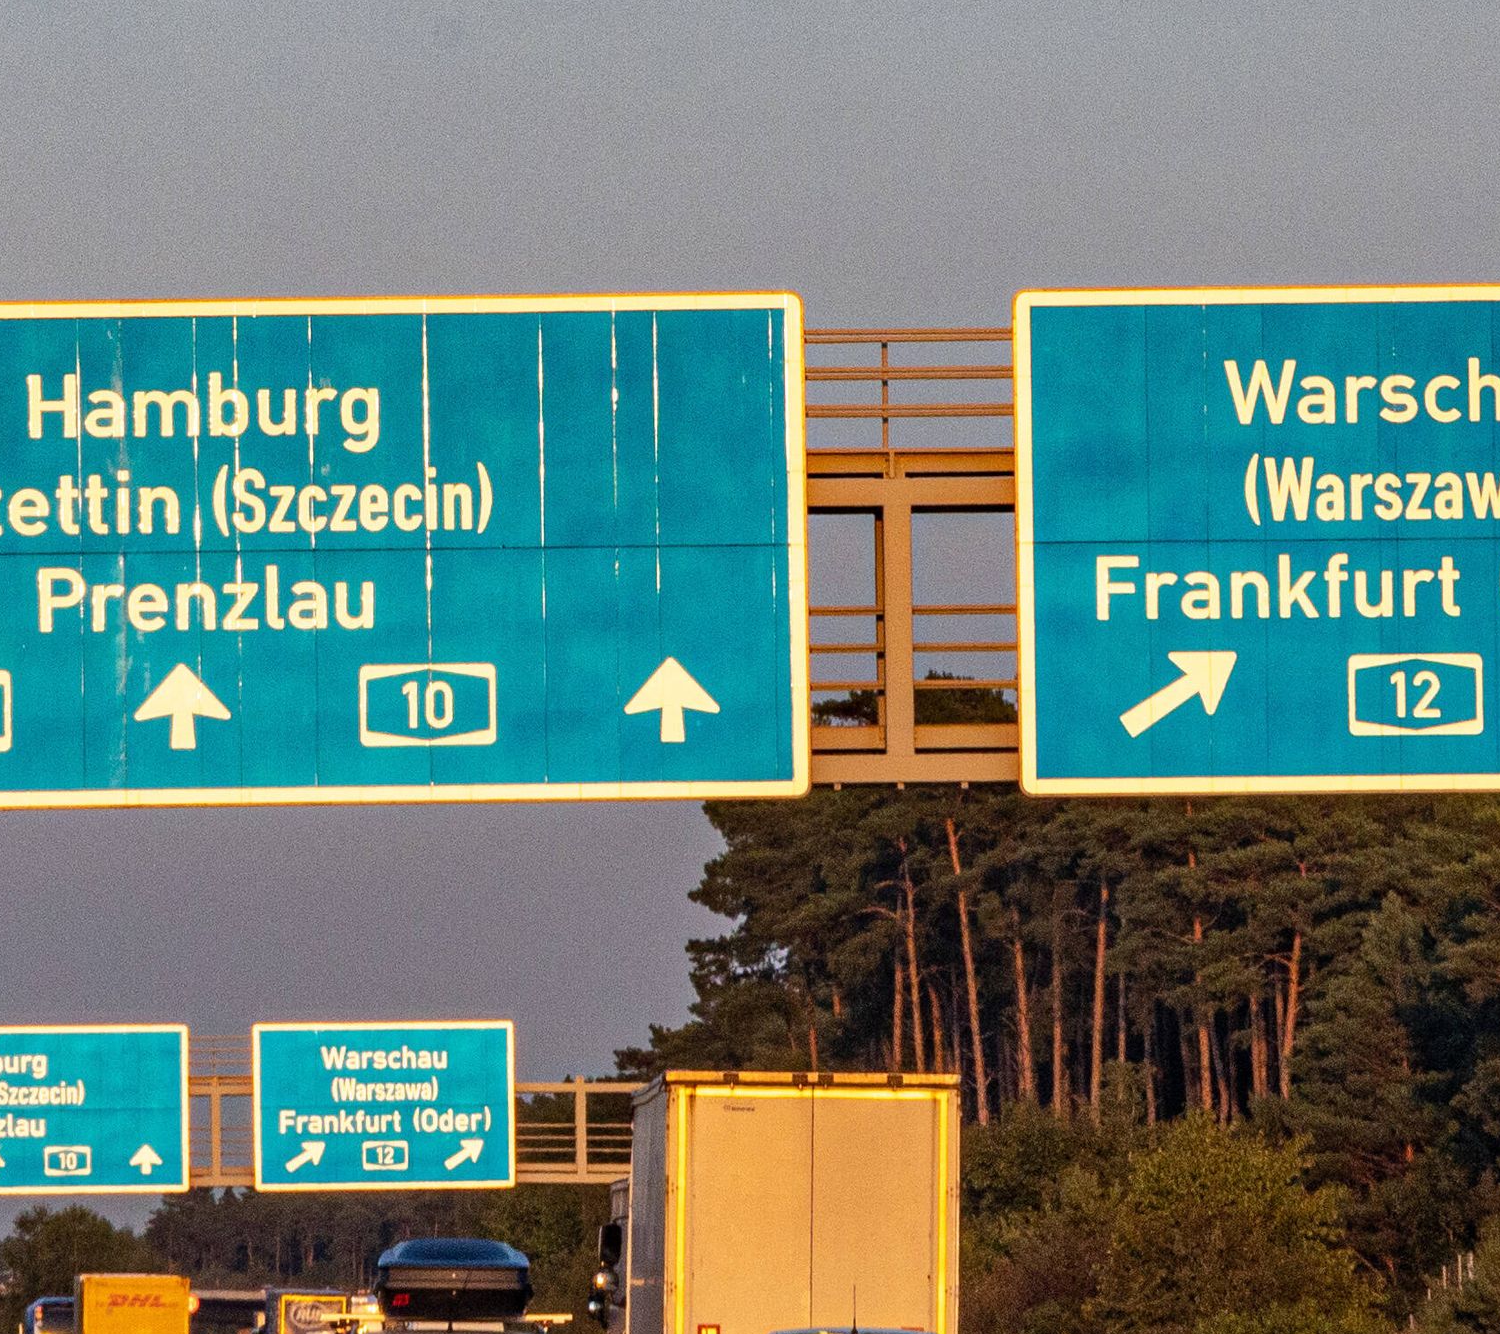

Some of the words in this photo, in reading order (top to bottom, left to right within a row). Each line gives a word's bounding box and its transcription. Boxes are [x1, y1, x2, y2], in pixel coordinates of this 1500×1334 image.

[26, 371, 380, 453] Hamburg
[211, 462, 493, 536] (Szczecin)
[36, 564, 375, 633] Prenzlau
[1096, 552, 1461, 621] Frankfurt
[401, 680, 455, 730] 10
[1390, 670, 1442, 719] 12
[320, 1045, 448, 1070] Warschau
[330, 1075, 438, 1102] (Warszawa)
[279, 1109, 402, 1134] Frankfurt
[413, 1106, 491, 1132] (Oder)
[58, 1152, 78, 1170] 10
[376, 1146, 395, 1164] 12
